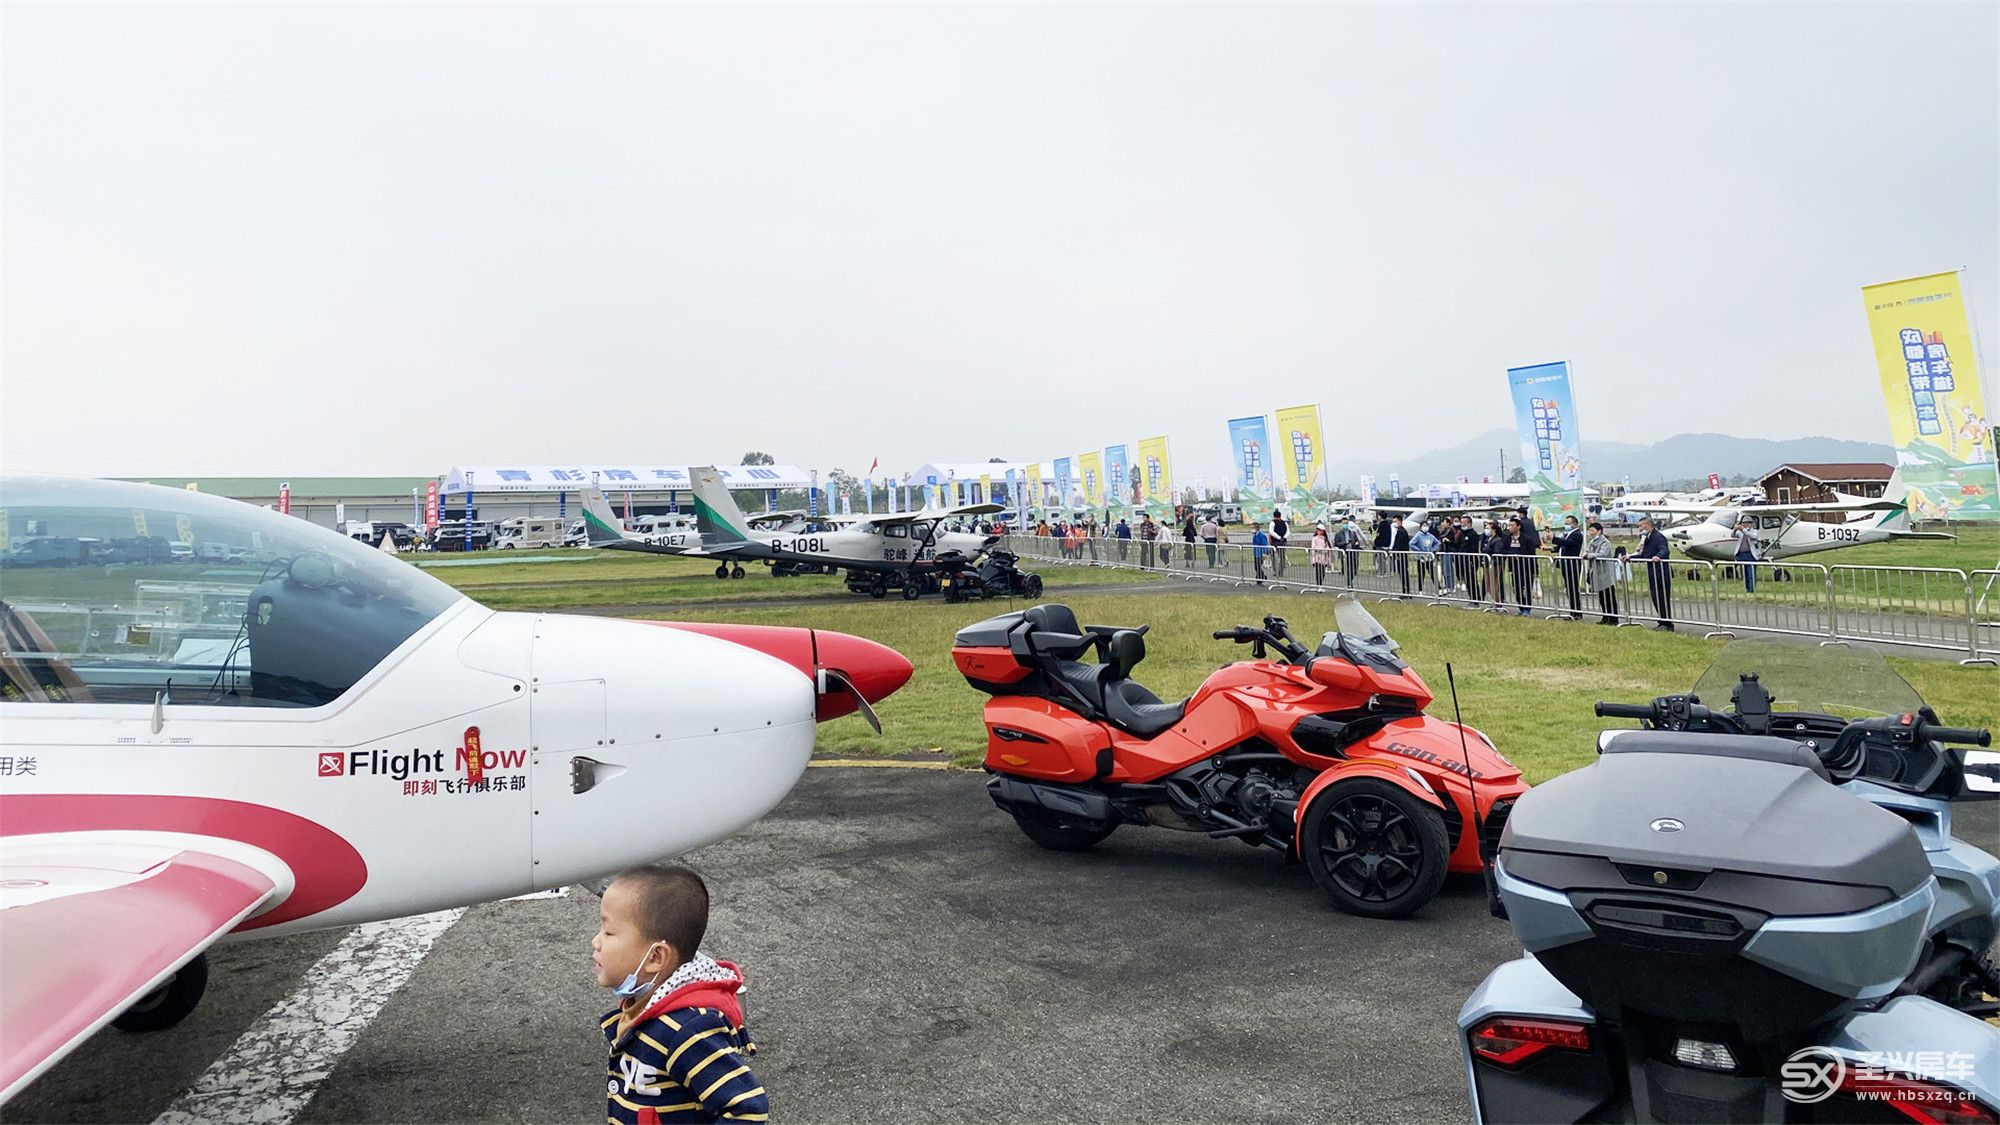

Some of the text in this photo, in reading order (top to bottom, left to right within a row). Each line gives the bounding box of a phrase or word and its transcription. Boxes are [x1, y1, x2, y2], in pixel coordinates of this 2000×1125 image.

[645, 535, 686, 548] B-10E7
[1818, 528, 1860, 542] B-109Z
[771, 538, 830, 553] B-108L
[349, 748, 444, 781] Flight
[403, 775, 526, 797] 即刻飞行俱乐部
